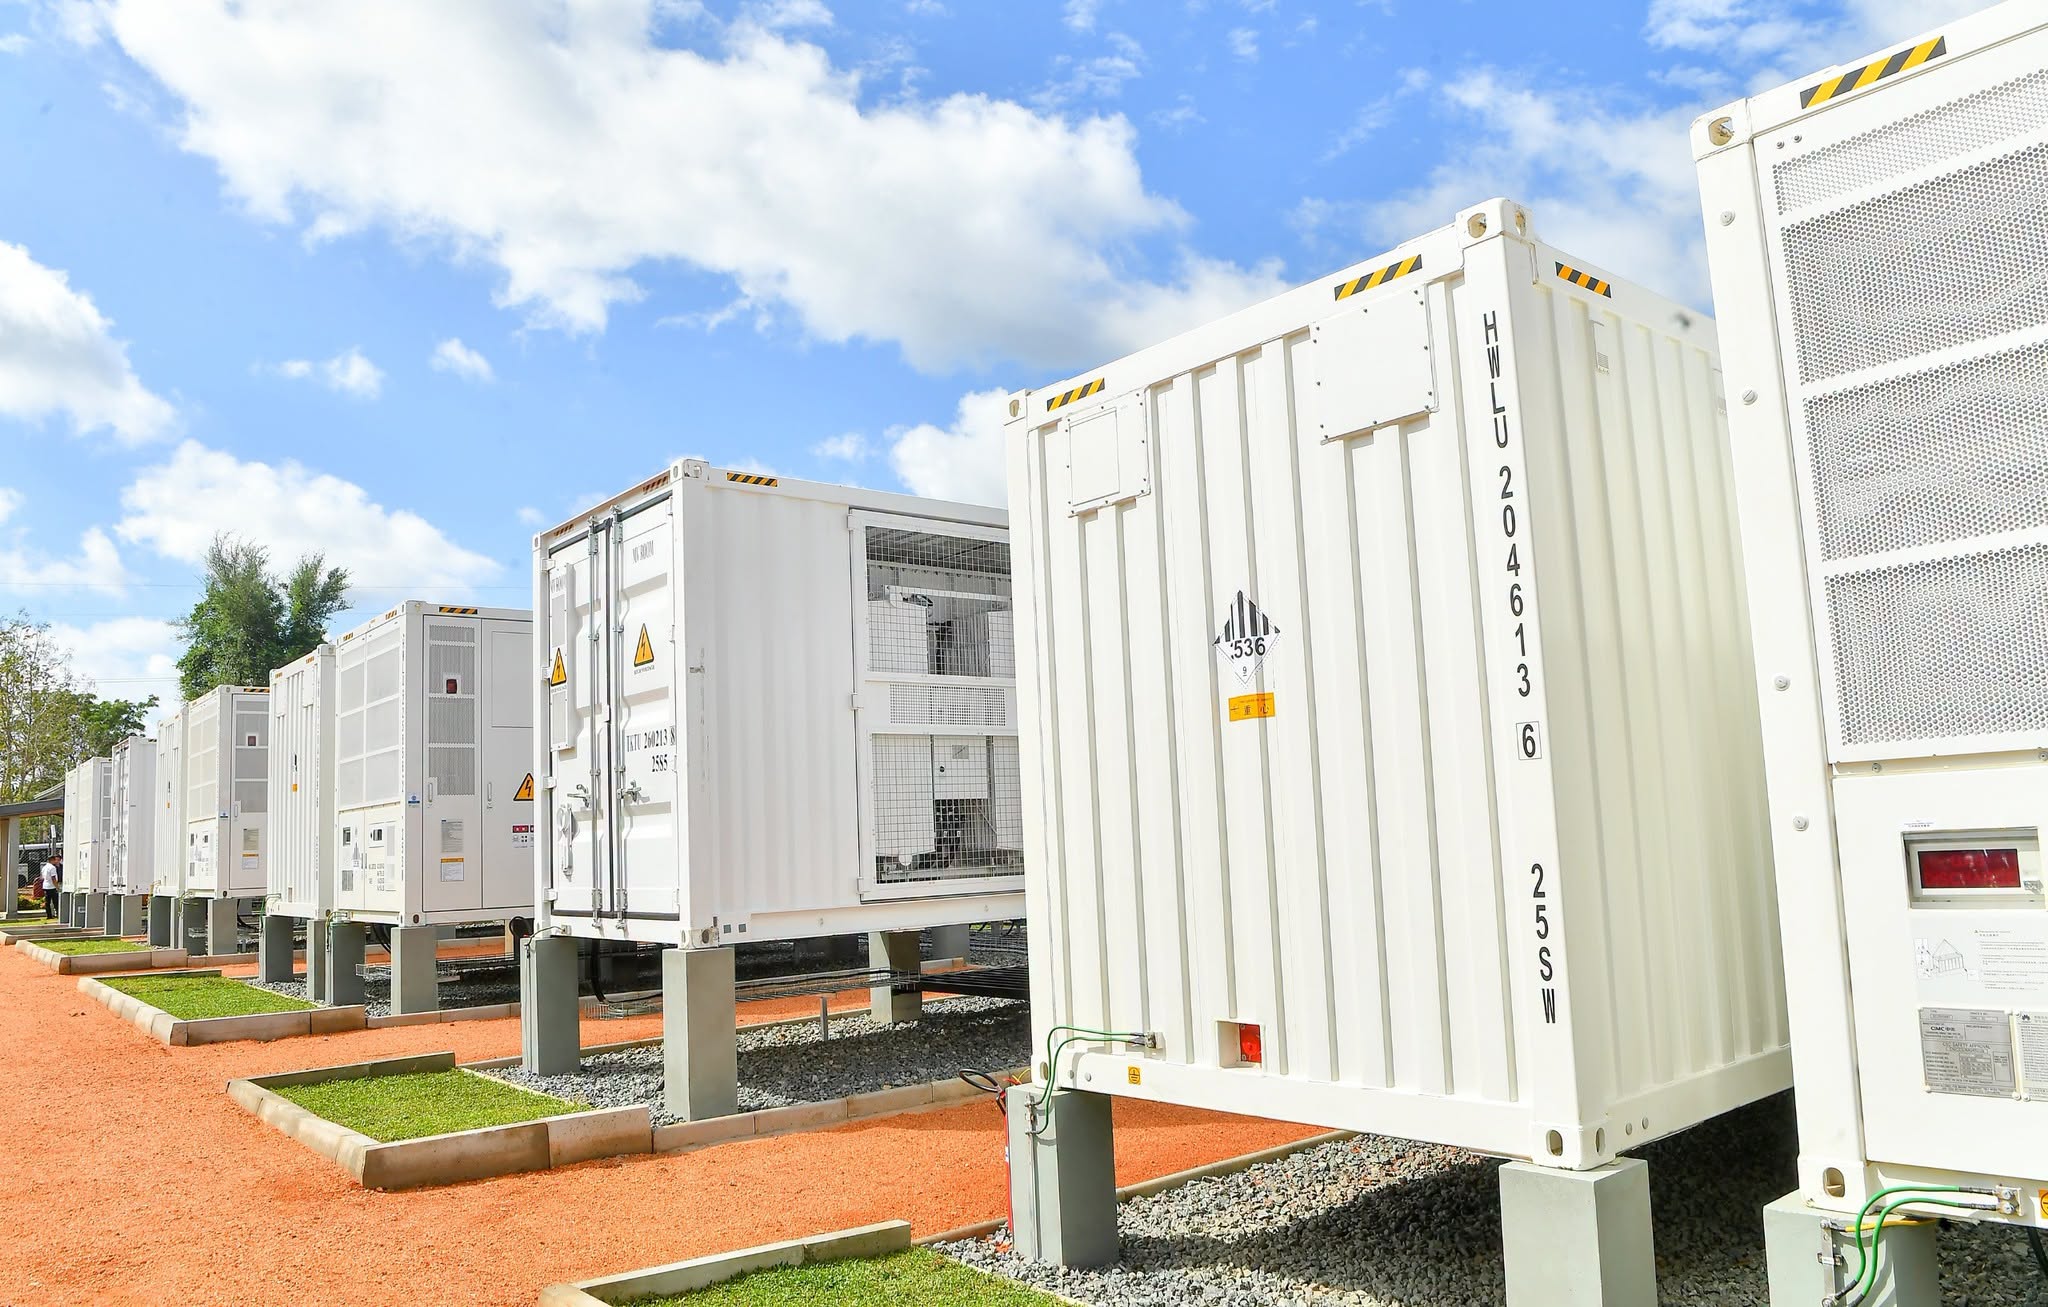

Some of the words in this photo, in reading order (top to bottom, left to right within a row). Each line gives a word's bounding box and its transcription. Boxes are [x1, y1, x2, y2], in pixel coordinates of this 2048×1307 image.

[1483, 310, 1509, 449] HWLU
[1499, 465, 1531, 698] 204613
[1521, 723, 1536, 758] 6
[1242, 666, 1248, 675] 9
[643, 728, 668, 749] 260213
[1531, 863, 1556, 1024] 25SW
